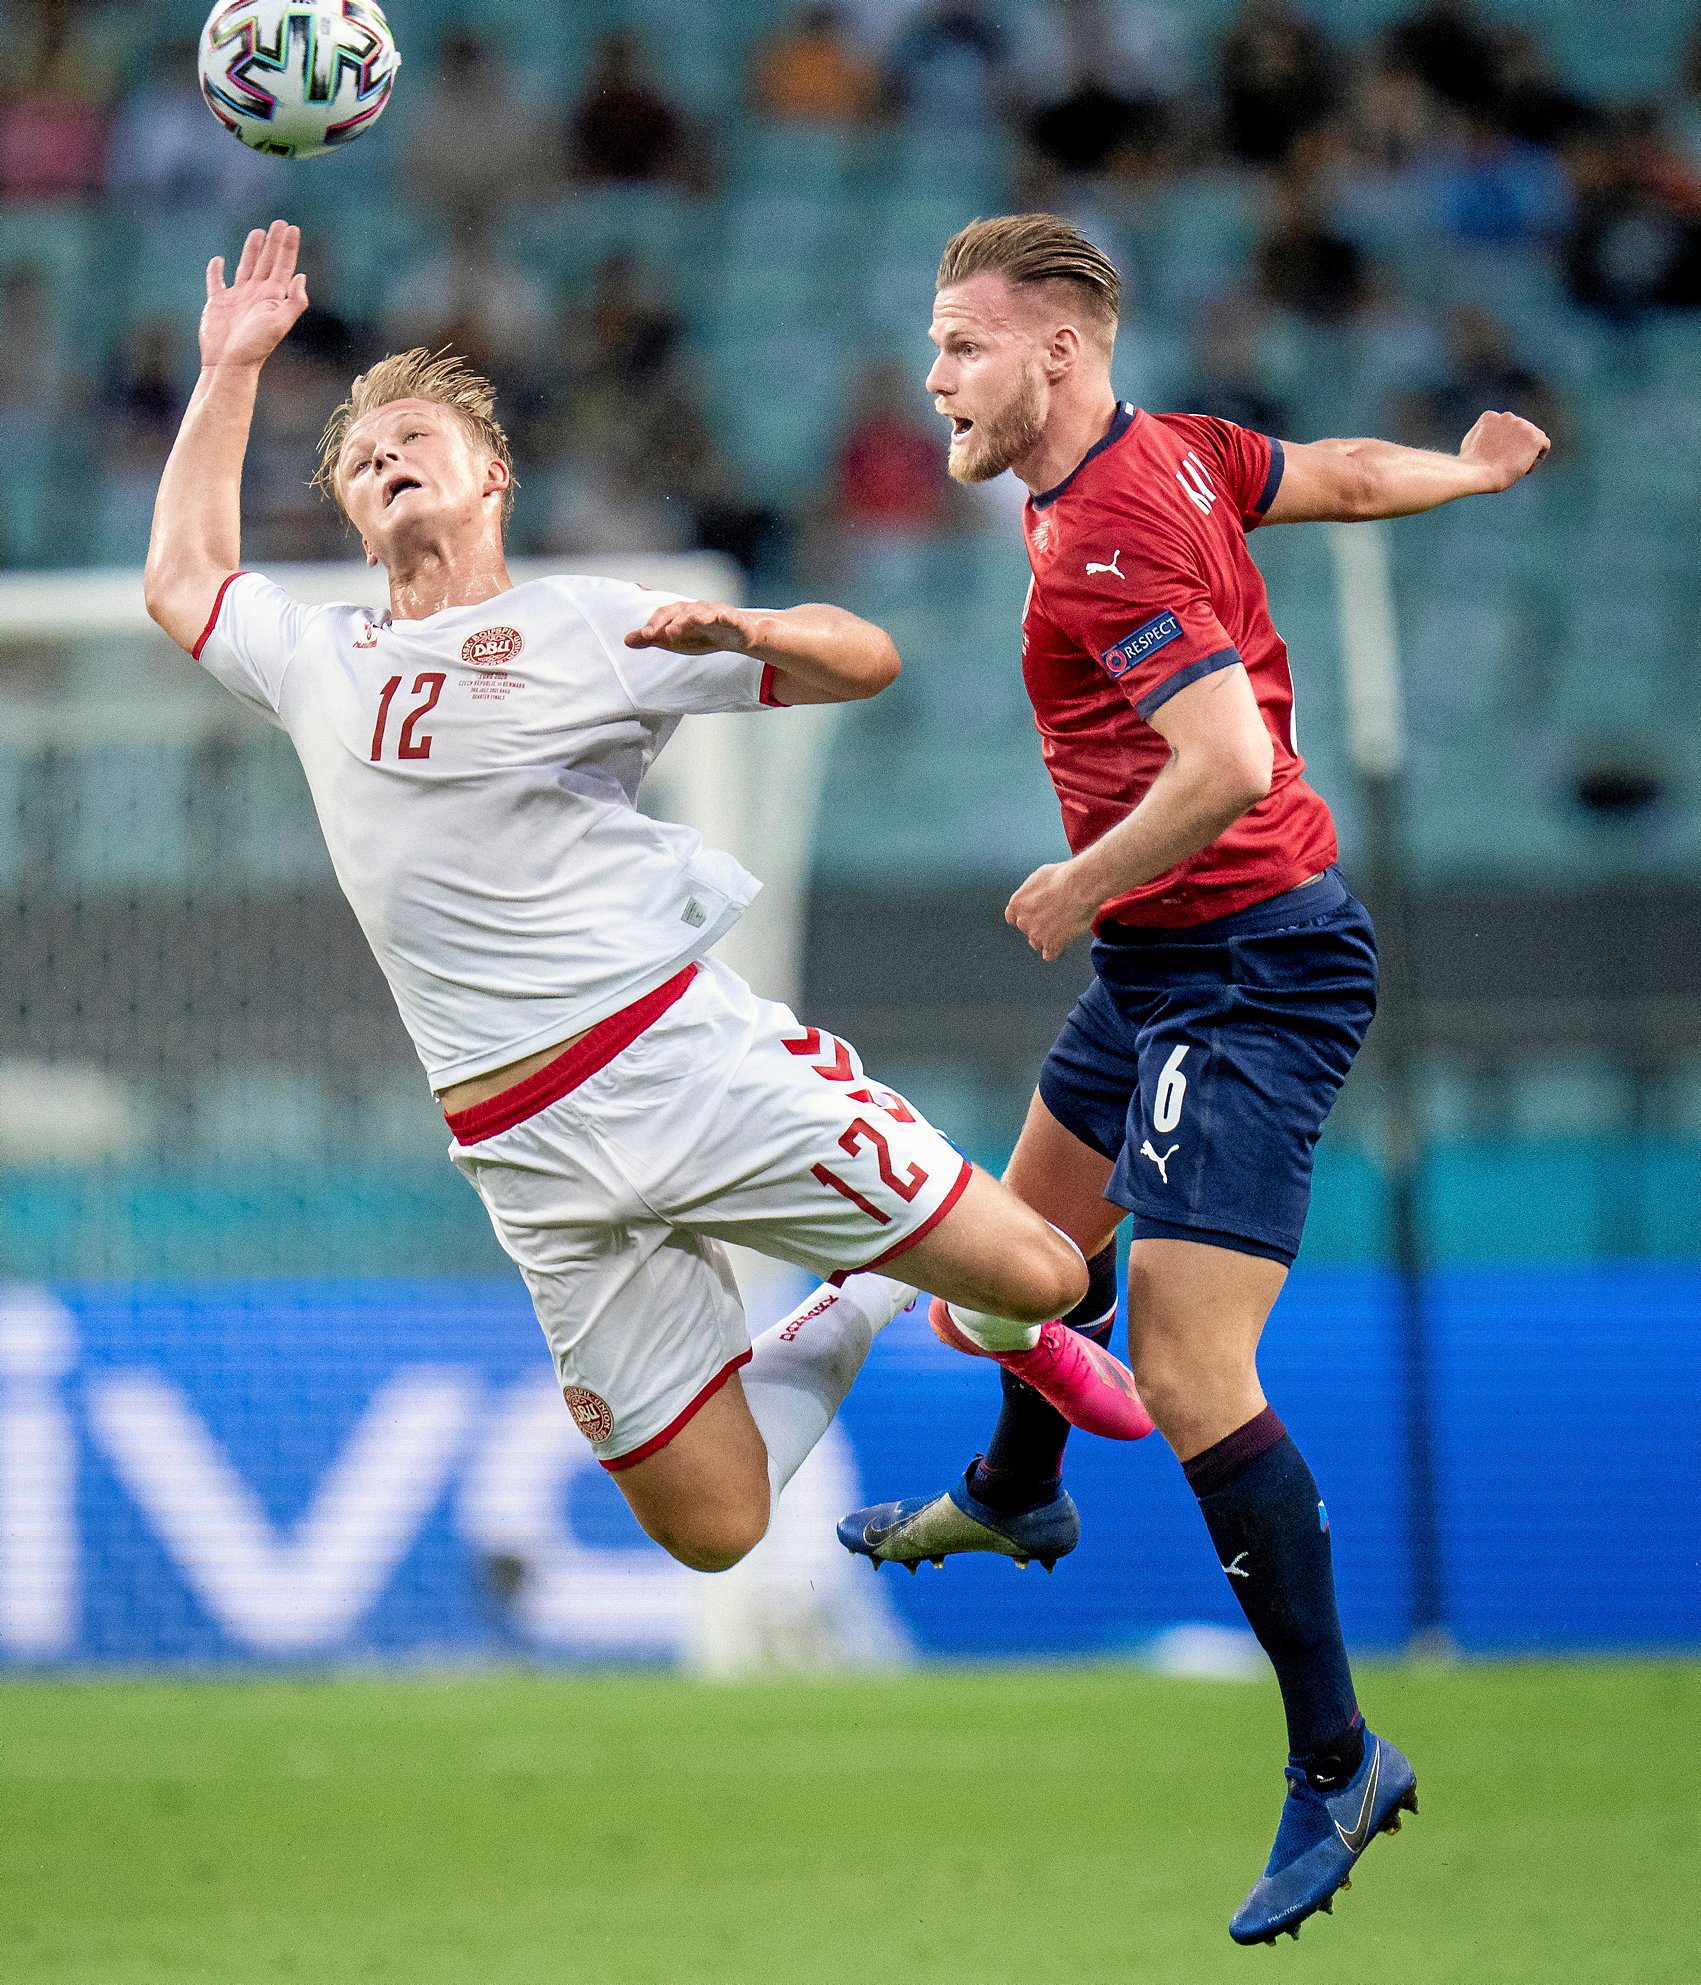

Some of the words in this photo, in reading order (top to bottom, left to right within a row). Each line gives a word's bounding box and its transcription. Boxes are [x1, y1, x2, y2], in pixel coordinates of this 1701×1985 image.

[473, 640, 512, 657] DBU
[1124, 616, 1177, 659] RESPECT
[474, 680, 497, 688] REPUBLIC
[502, 681, 526, 689] DENMARK
[370, 672, 447, 761] 12
[1153, 1044, 1190, 1133] 6
[810, 1117, 929, 1226] 12
[594, 1398, 612, 1430] UNION
